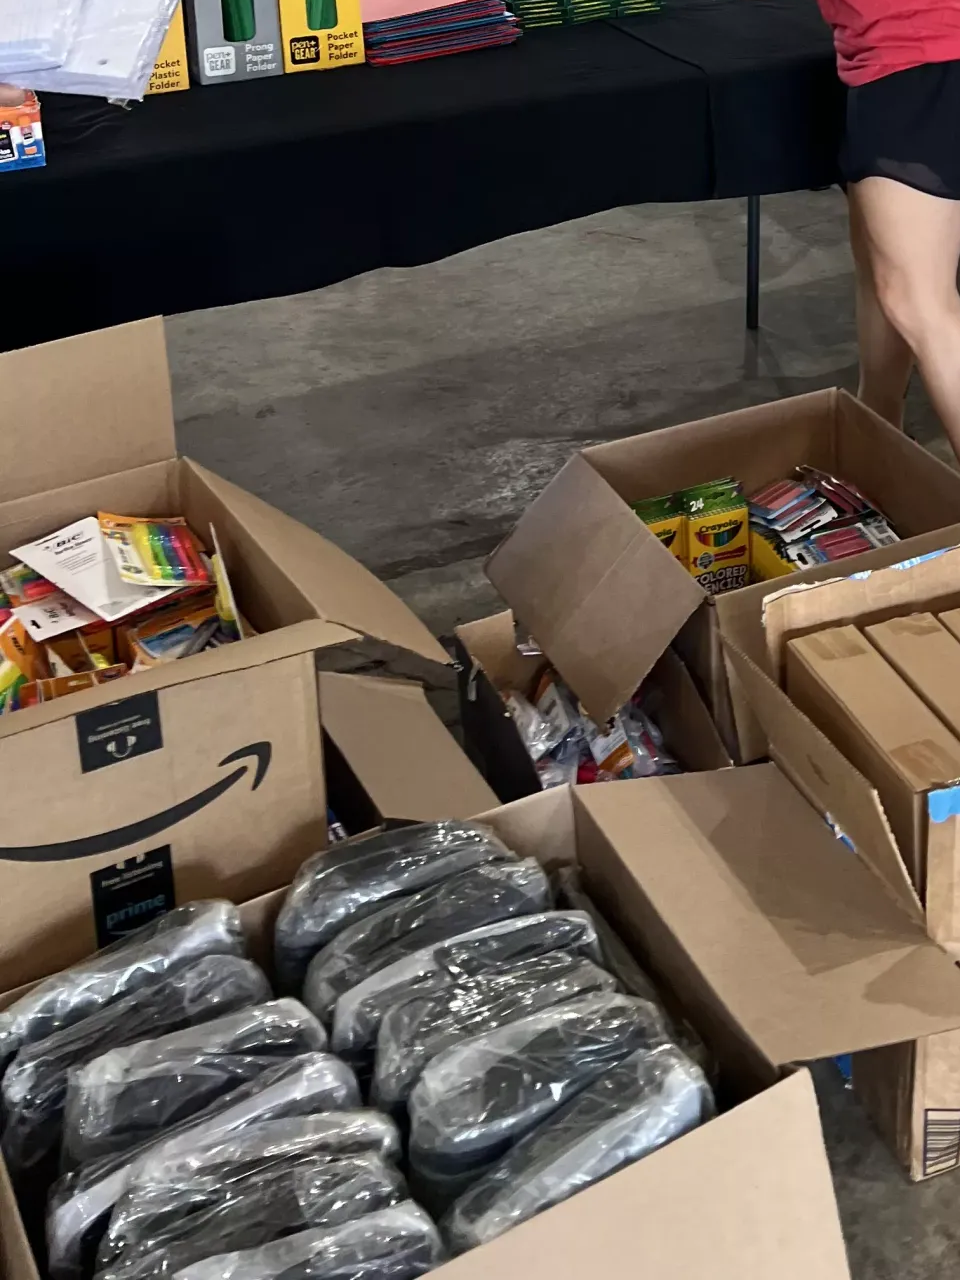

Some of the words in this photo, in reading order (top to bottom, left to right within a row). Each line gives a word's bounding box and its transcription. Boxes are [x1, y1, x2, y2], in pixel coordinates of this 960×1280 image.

[327, 31, 358, 41] Pocket
[244, 43, 274, 53] Prong
[328, 41, 354, 52] Paper
[245, 52, 273, 63] Paper
[294, 48, 318, 60] GEAR
[328, 50, 358, 61] Folder
[153, 59, 181, 70] ocket
[209, 59, 232, 71] GEAR
[246, 62, 277, 72] Folder
[150, 80, 181, 91] Folder
[689, 497, 705, 512] 24
[698, 519, 739, 534] Crayola
[695, 565, 748, 584] OLORED
[704, 577, 745, 594] ENCILS
[106, 894, 165, 930] prime
